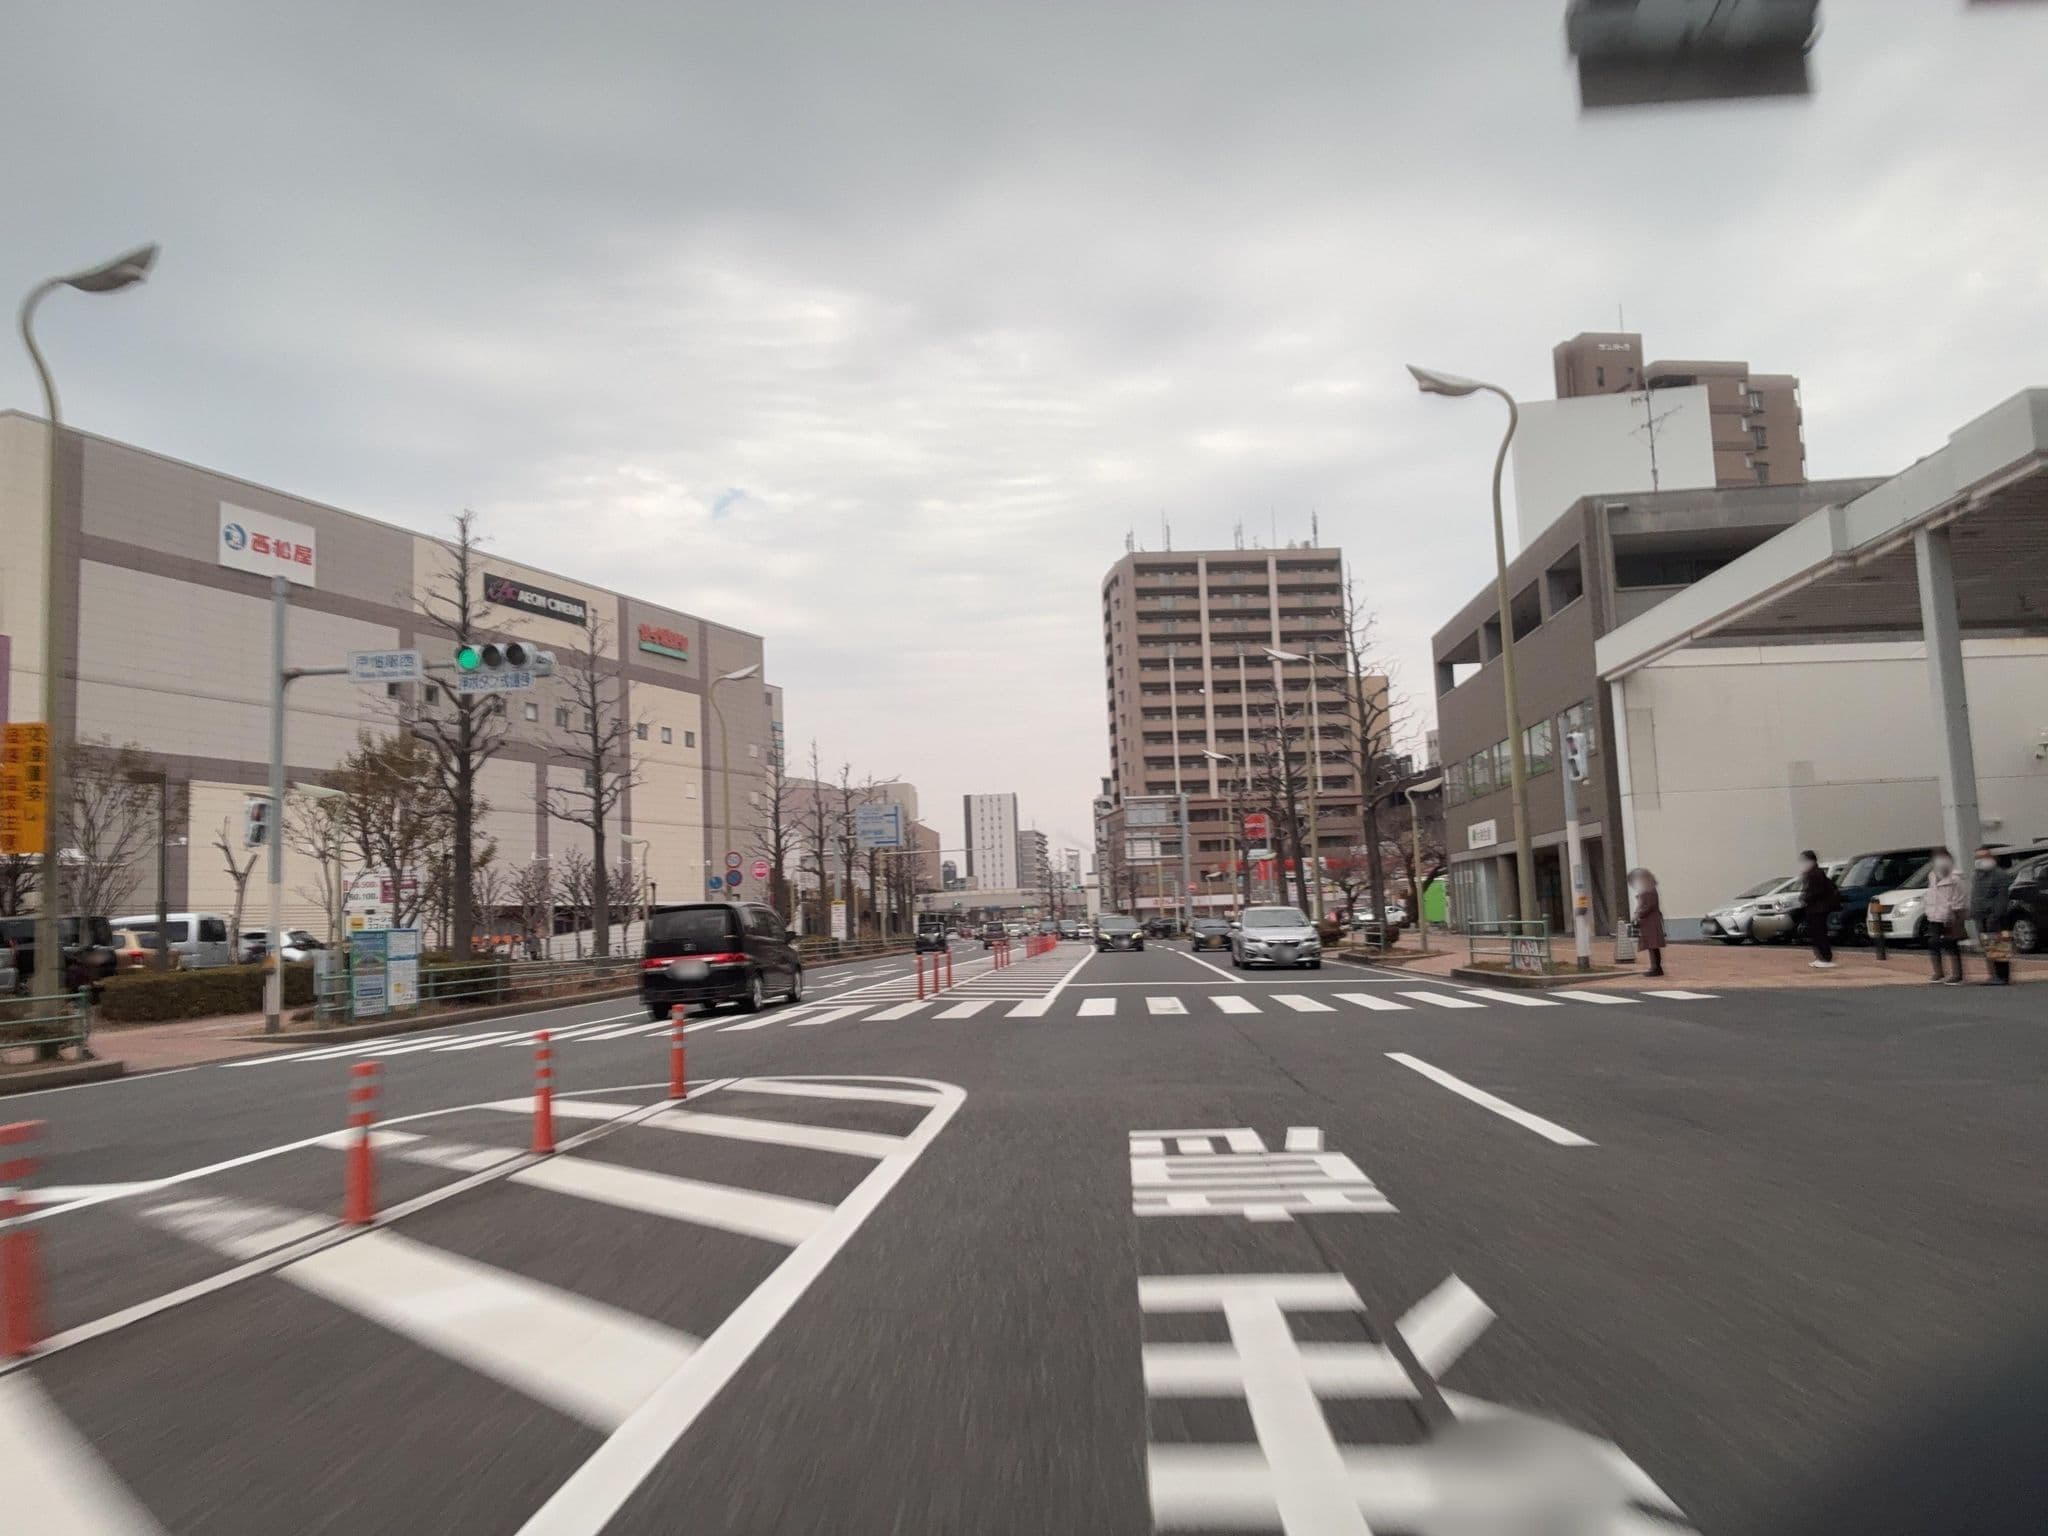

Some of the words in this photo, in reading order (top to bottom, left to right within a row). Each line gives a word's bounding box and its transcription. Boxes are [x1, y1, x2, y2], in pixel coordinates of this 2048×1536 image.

[250, 532, 312, 566] 西松屋
[517, 590, 547, 609] AEON
[547, 597, 585, 618] CINEMA
